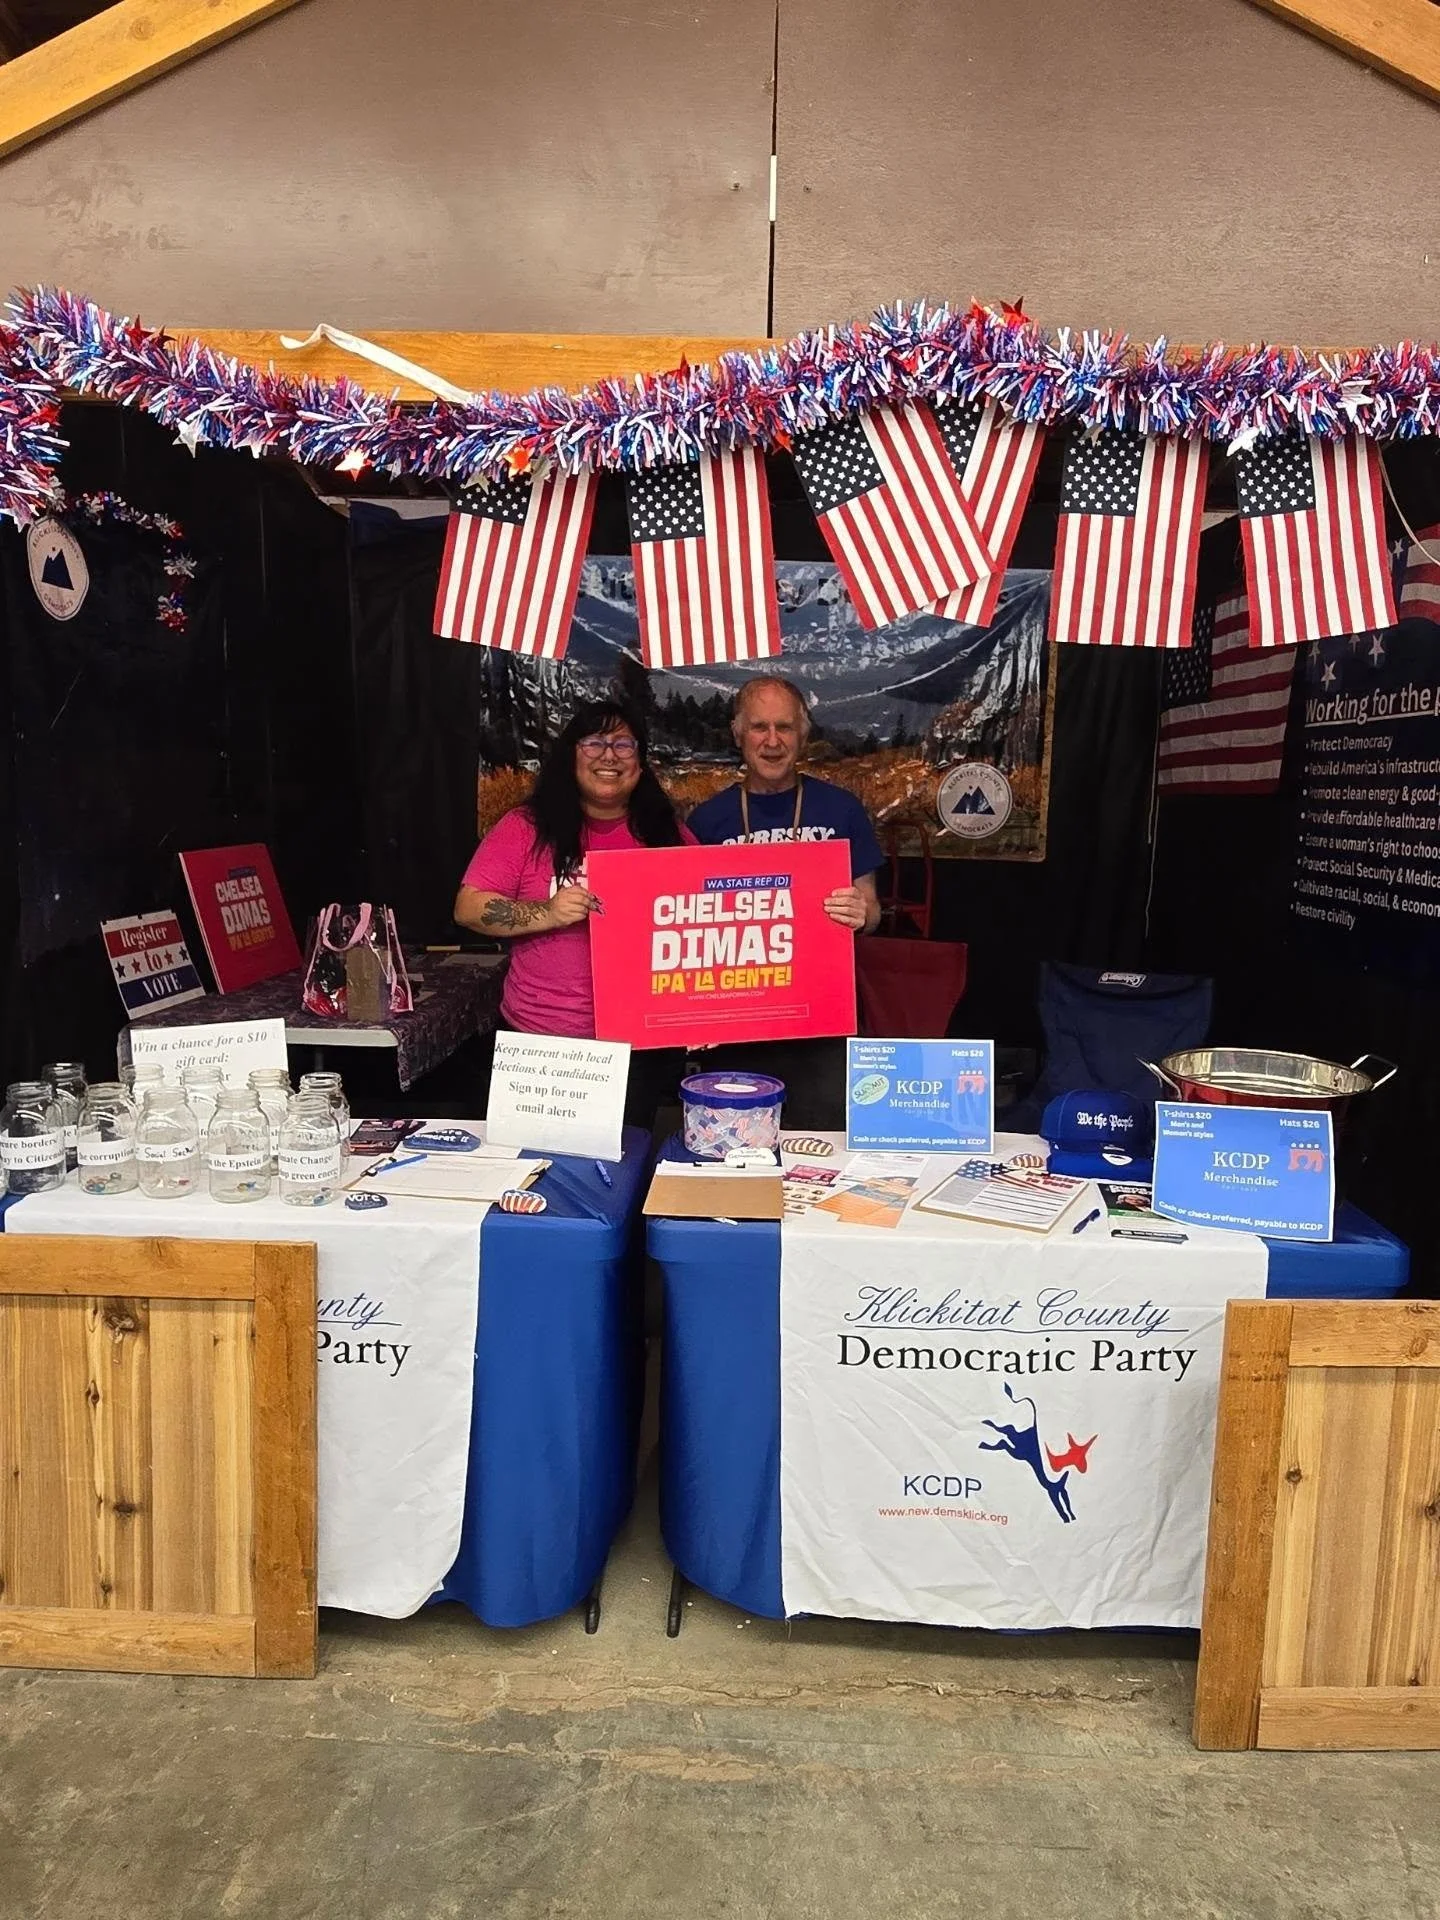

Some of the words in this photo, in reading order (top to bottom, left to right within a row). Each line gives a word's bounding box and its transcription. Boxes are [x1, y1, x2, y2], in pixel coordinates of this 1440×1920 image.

[1305, 692, 1370, 725] Working
[1372, 688, 1397, 716] for
[1401, 682, 1431, 712] the
[1343, 736, 1393, 752] Democracy
[1341, 760, 1385, 775] America's
[1368, 787, 1400, 805] energy
[1401, 785, 1410, 801] &
[1384, 811, 1436, 830] healthcare
[1335, 837, 1375, 853] woman's
[1376, 838, 1400, 858] right
[1401, 842, 1411, 857] to
[706, 879, 725, 890] WA
[726, 877, 752, 889] STATE
[754, 877, 772, 888] REP
[774, 876, 789, 888] (D)
[1330, 859, 1355, 877] Social
[1356, 862, 1396, 886] Security
[1397, 867, 1403, 884] &
[215, 875, 264, 904] CHELSEA
[653, 889, 794, 926] CHELSEA
[1363, 891, 1391, 912] social,
[1392, 894, 1399, 910] &
[221, 898, 272, 935] DIMAS
[1295, 901, 1326, 920] Restore
[1327, 908, 1356, 931] civility
[120, 925, 167, 950] Register
[651, 924, 793, 971] DIMAS
[144, 950, 162, 972] to
[142, 973, 183, 999] VOTE
[694, 970, 716, 993] LA
[720, 965, 792, 990] GENTE!
[133, 1041, 157, 1053] Win
[160, 1043, 168, 1051] a
[172, 1039, 213, 1050] chance
[215, 1036, 234, 1049] for
[247, 1031, 267, 1043] $10
[174, 1055, 196, 1070] gift
[199, 1052, 230, 1065] card:
[495, 1042, 520, 1055] Keep
[522, 1046, 560, 1059] current
[562, 1050, 584, 1061] with
[586, 1052, 613, 1065] local
[492, 1060, 536, 1074] elections
[538, 1065, 548, 1076] &
[551, 1067, 610, 1082] candidates:
[508, 1080, 532, 1095] Sign
[534, 1086, 548, 1098] up
[551, 1085, 567, 1097] for
[569, 1090, 588, 1100] our
[896, 1080, 943, 1095] KCDP
[515, 1103, 545, 1115] email
[547, 1105, 577, 1118] alerts
[889, 1098, 950, 1109] Merchandise
[1076, 1111, 1093, 1126] We
[1093, 1112, 1108, 1130] the
[1163, 1109, 1195, 1119] T-shirts
[1195, 1111, 1212, 1120] $20
[1279, 1118, 1302, 1128] Hats
[21, 1138, 57, 1149] borders
[13, 1156, 23, 1164] to
[213, 1159, 227, 1168] the
[228, 1157, 262, 1170] Epstein
[1212, 1151, 1270, 1170] KCDP
[291, 1172, 315, 1180] green
[1203, 1171, 1280, 1187] Merchandise
[1158, 1200, 1177, 1212] Cash
[1178, 1207, 1187, 1215] or
[1288, 1221, 1298, 1230] to
[844, 1285, 1023, 1327] Klickitat
[1036, 1287, 1171, 1339] County
[837, 1334, 1077, 1375] Democratic
[1090, 1338, 1199, 1382] Party
[903, 1474, 983, 1499] KCDP
[878, 1505, 1009, 1526] www.new.demsklick.org
